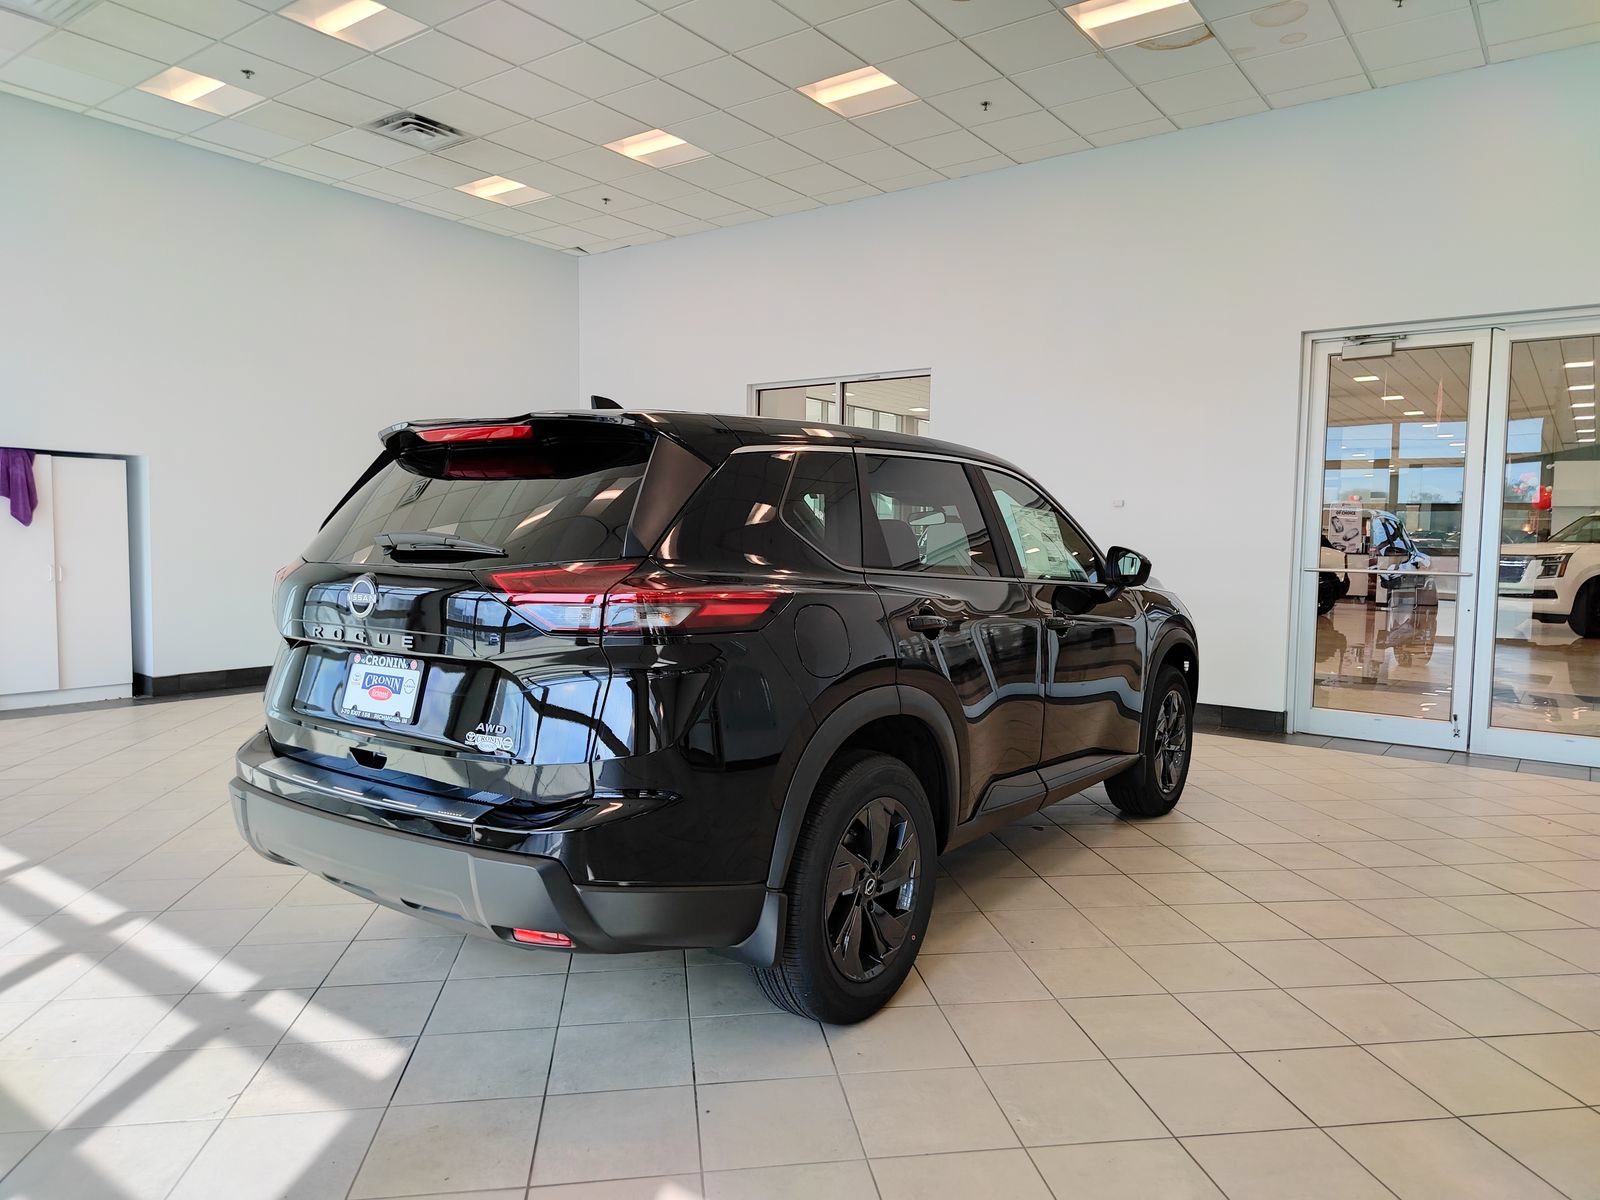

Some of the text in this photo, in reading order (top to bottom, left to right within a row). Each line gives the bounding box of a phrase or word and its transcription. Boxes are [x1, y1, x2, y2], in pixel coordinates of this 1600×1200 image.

[347, 592, 377, 603] NISSAN
[313, 626, 414, 648] ROGUE
[365, 654, 405, 669] CRONIN
[365, 674, 402, 692] CRONIN
[475, 722, 505, 734] AWD
[476, 735, 503, 748] CRONIN
